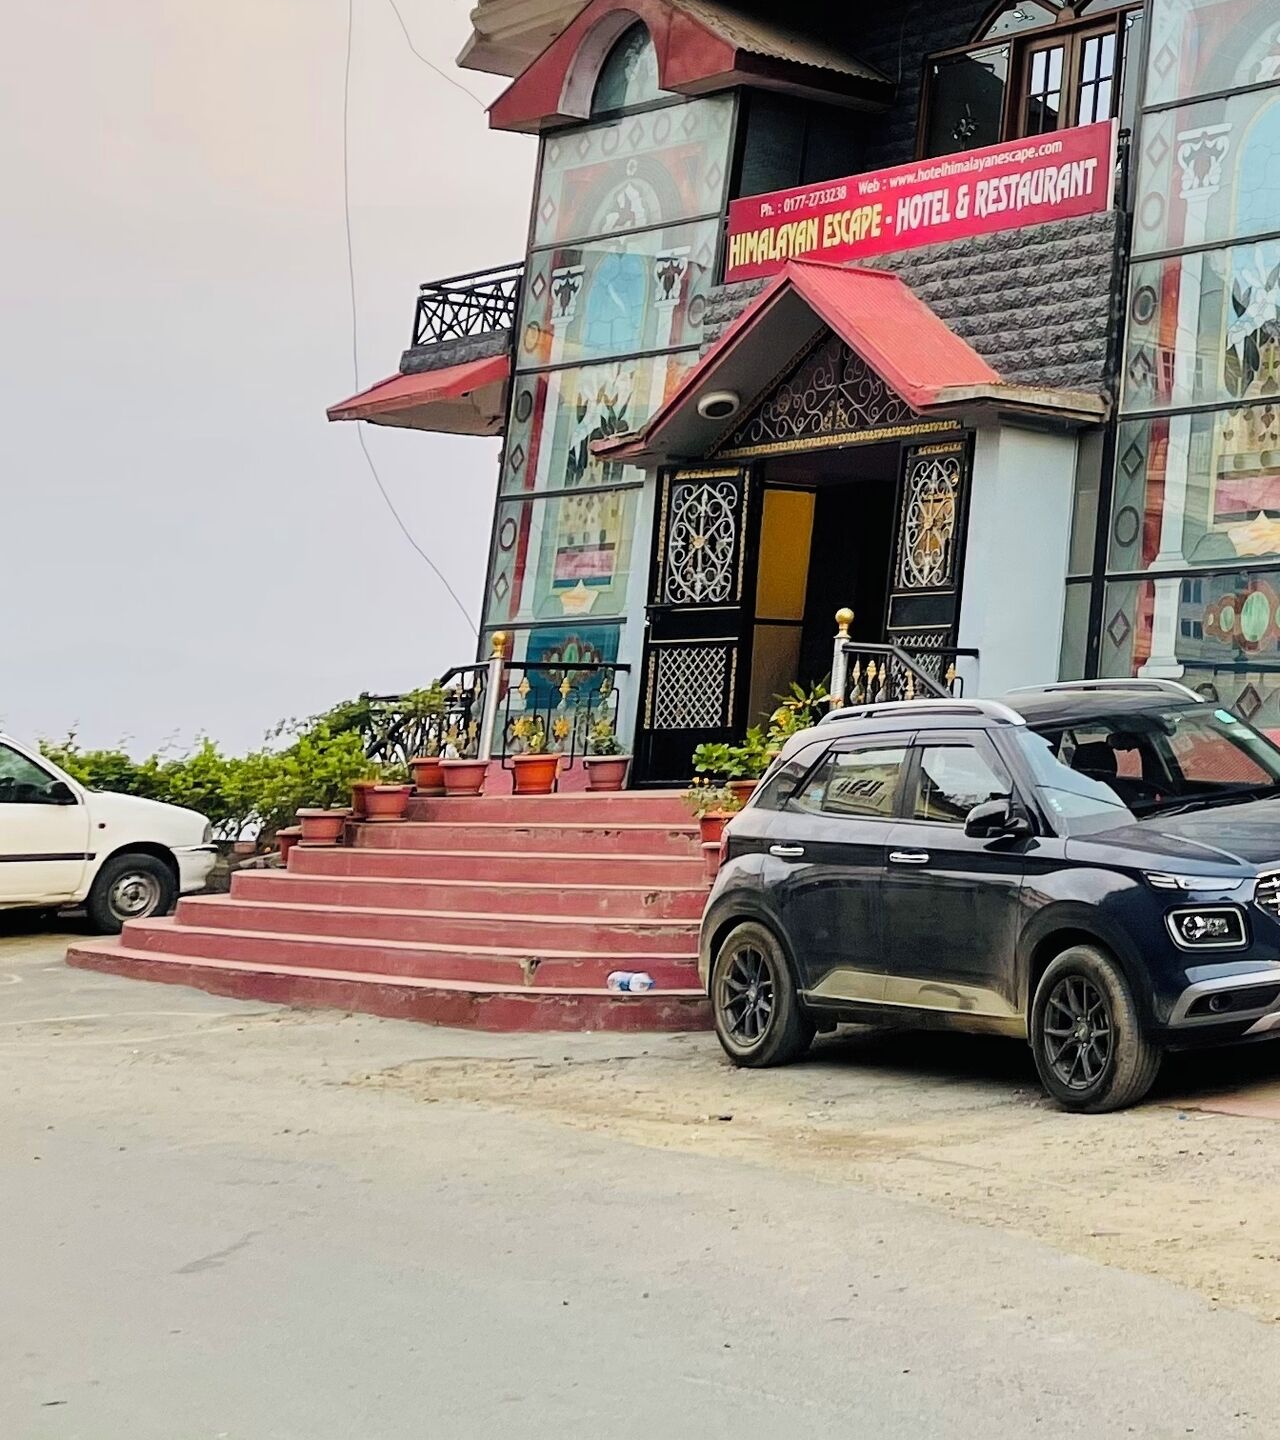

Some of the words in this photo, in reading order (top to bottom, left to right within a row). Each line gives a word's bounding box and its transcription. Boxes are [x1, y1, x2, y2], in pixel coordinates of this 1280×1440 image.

[728, 216, 819, 271] HIMALAYAN
[822, 203, 883, 248] ESCAPE
[895, 189, 950, 235] HOTEL
[955, 184, 971, 220] &
[974, 157, 1098, 219] RESTAURANT
[783, 185, 847, 213] 0177-2733238
[858, 180, 880, 196] Web
[889, 141, 1063, 188] www.hotelhimalayanescape.com
